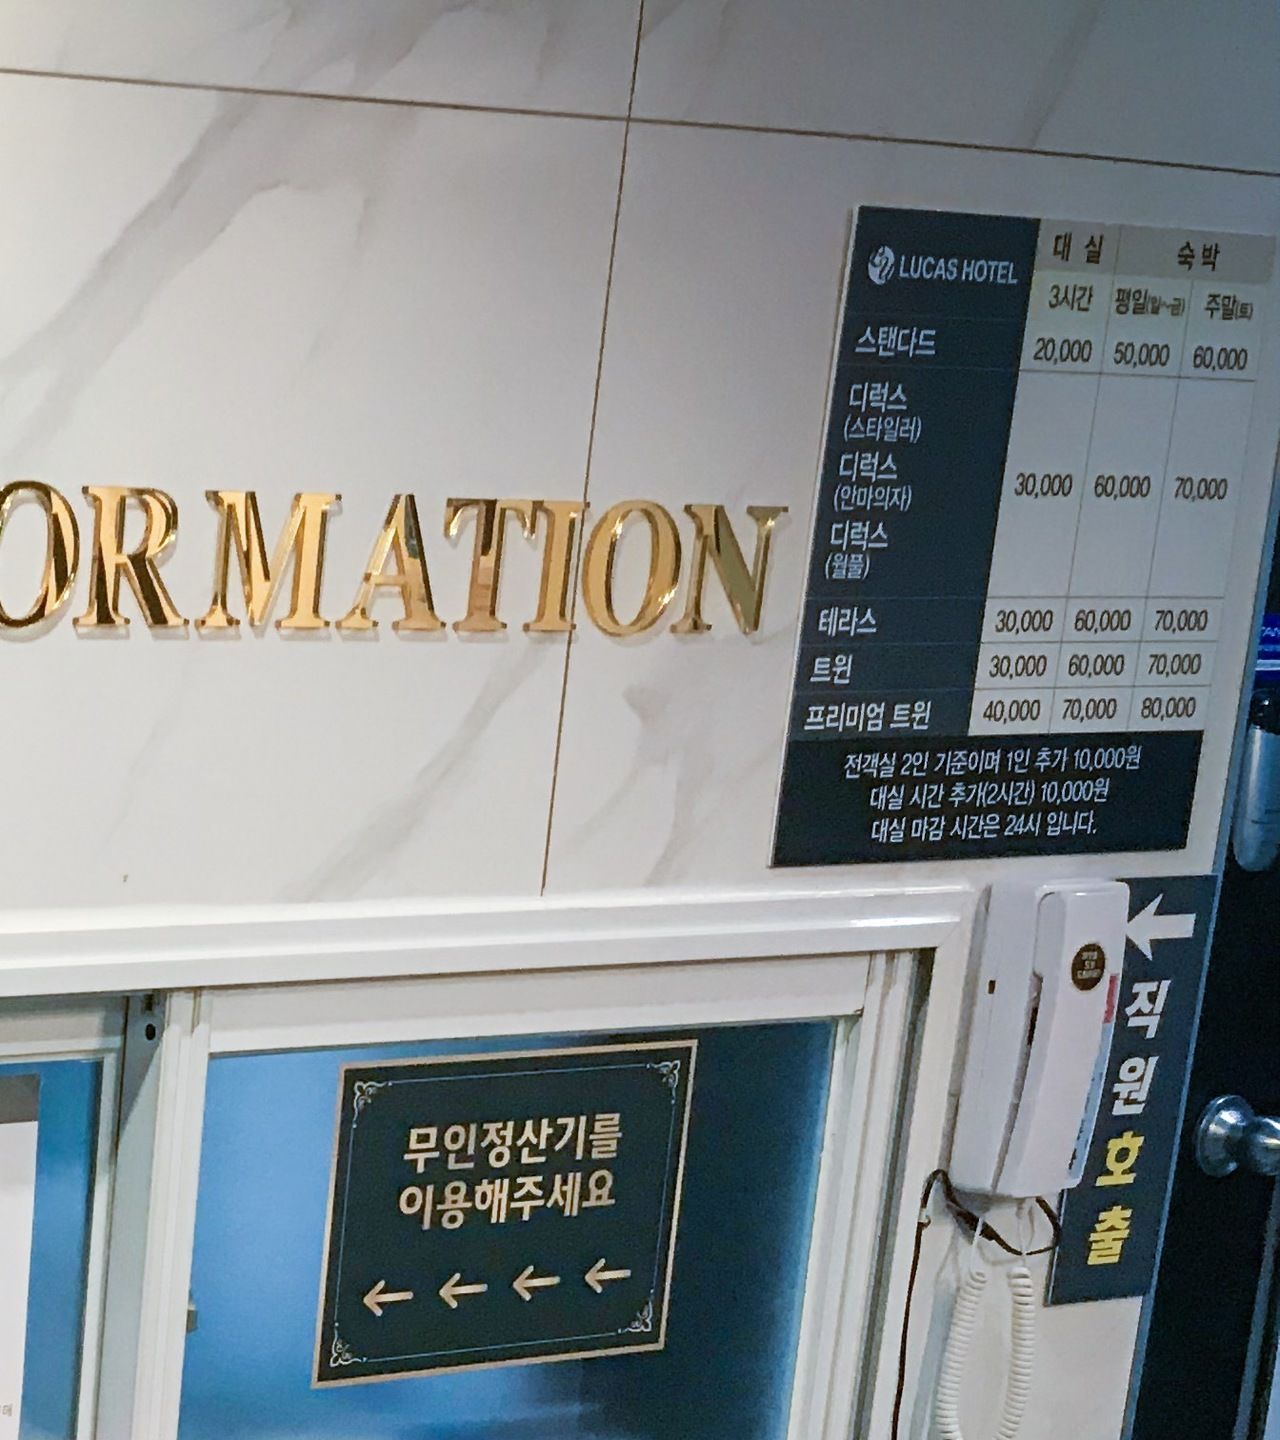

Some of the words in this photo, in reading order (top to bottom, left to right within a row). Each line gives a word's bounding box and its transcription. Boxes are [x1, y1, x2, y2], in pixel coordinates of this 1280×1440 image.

[898, 254, 958, 282] LUCAS
[963, 260, 1017, 284] HOTEL
[1048, 284, 1093, 313] 3시간
[855, 326, 936, 358] 스탠다드
[1033, 337, 1093, 366] 20,000
[1114, 342, 1170, 369] 50,000
[1193, 346, 1248, 372] 60,000
[848, 380, 907, 411] 디럭스
[843, 414, 922, 444] (스타일러)
[840, 449, 897, 480] 디럭스
[833, 483, 912, 512] (안마의자)
[1015, 472, 1074, 499] 30,000
[1094, 473, 1151, 500] 60,000
[1174, 476, 1228, 502] 70,000
[830, 519, 888, 550] 디럭스
[824, 552, 870, 581] (월풀)
[818, 606, 877, 636] 테라스
[995, 608, 1053, 634] 30,000
[1074, 607, 1131, 634] 60,000
[1153, 607, 1208, 634] 70,000
[810, 655, 853, 684] 트윈
[988, 653, 1047, 679] 30,000
[1068, 653, 1125, 679] 60,000
[1147, 652, 1201, 677] 70,000
[804, 703, 885, 731] 프리미엄
[890, 700, 931, 730] 트윈
[982, 696, 1041, 724] 40,000
[1062, 696, 1118, 722] 70,000
[1140, 695, 1197, 720] 80,000
[844, 750, 897, 778] 전객실
[901, 750, 929, 775] 2인
[932, 748, 1003, 776] 기준이며
[1005, 748, 1032, 773] 1인
[1035, 748, 1070, 774] 추가
[1074, 745, 1142, 773] 10,000원
[870, 783, 905, 810] 대실
[910, 783, 943, 808] 시간
[947, 780, 1037, 809] 추가(2시간)
[1040, 778, 1109, 806] 10,000원
[871, 817, 906, 843] 대실
[910, 815, 945, 841] 마감
[951, 814, 1001, 841] 시간은
[1005, 812, 1042, 838] 24시
[1046, 811, 1098, 838] 입니다.
[403, 1112, 623, 1175] 무인정산기를
[398, 1168, 616, 1231] 이용해주세요
